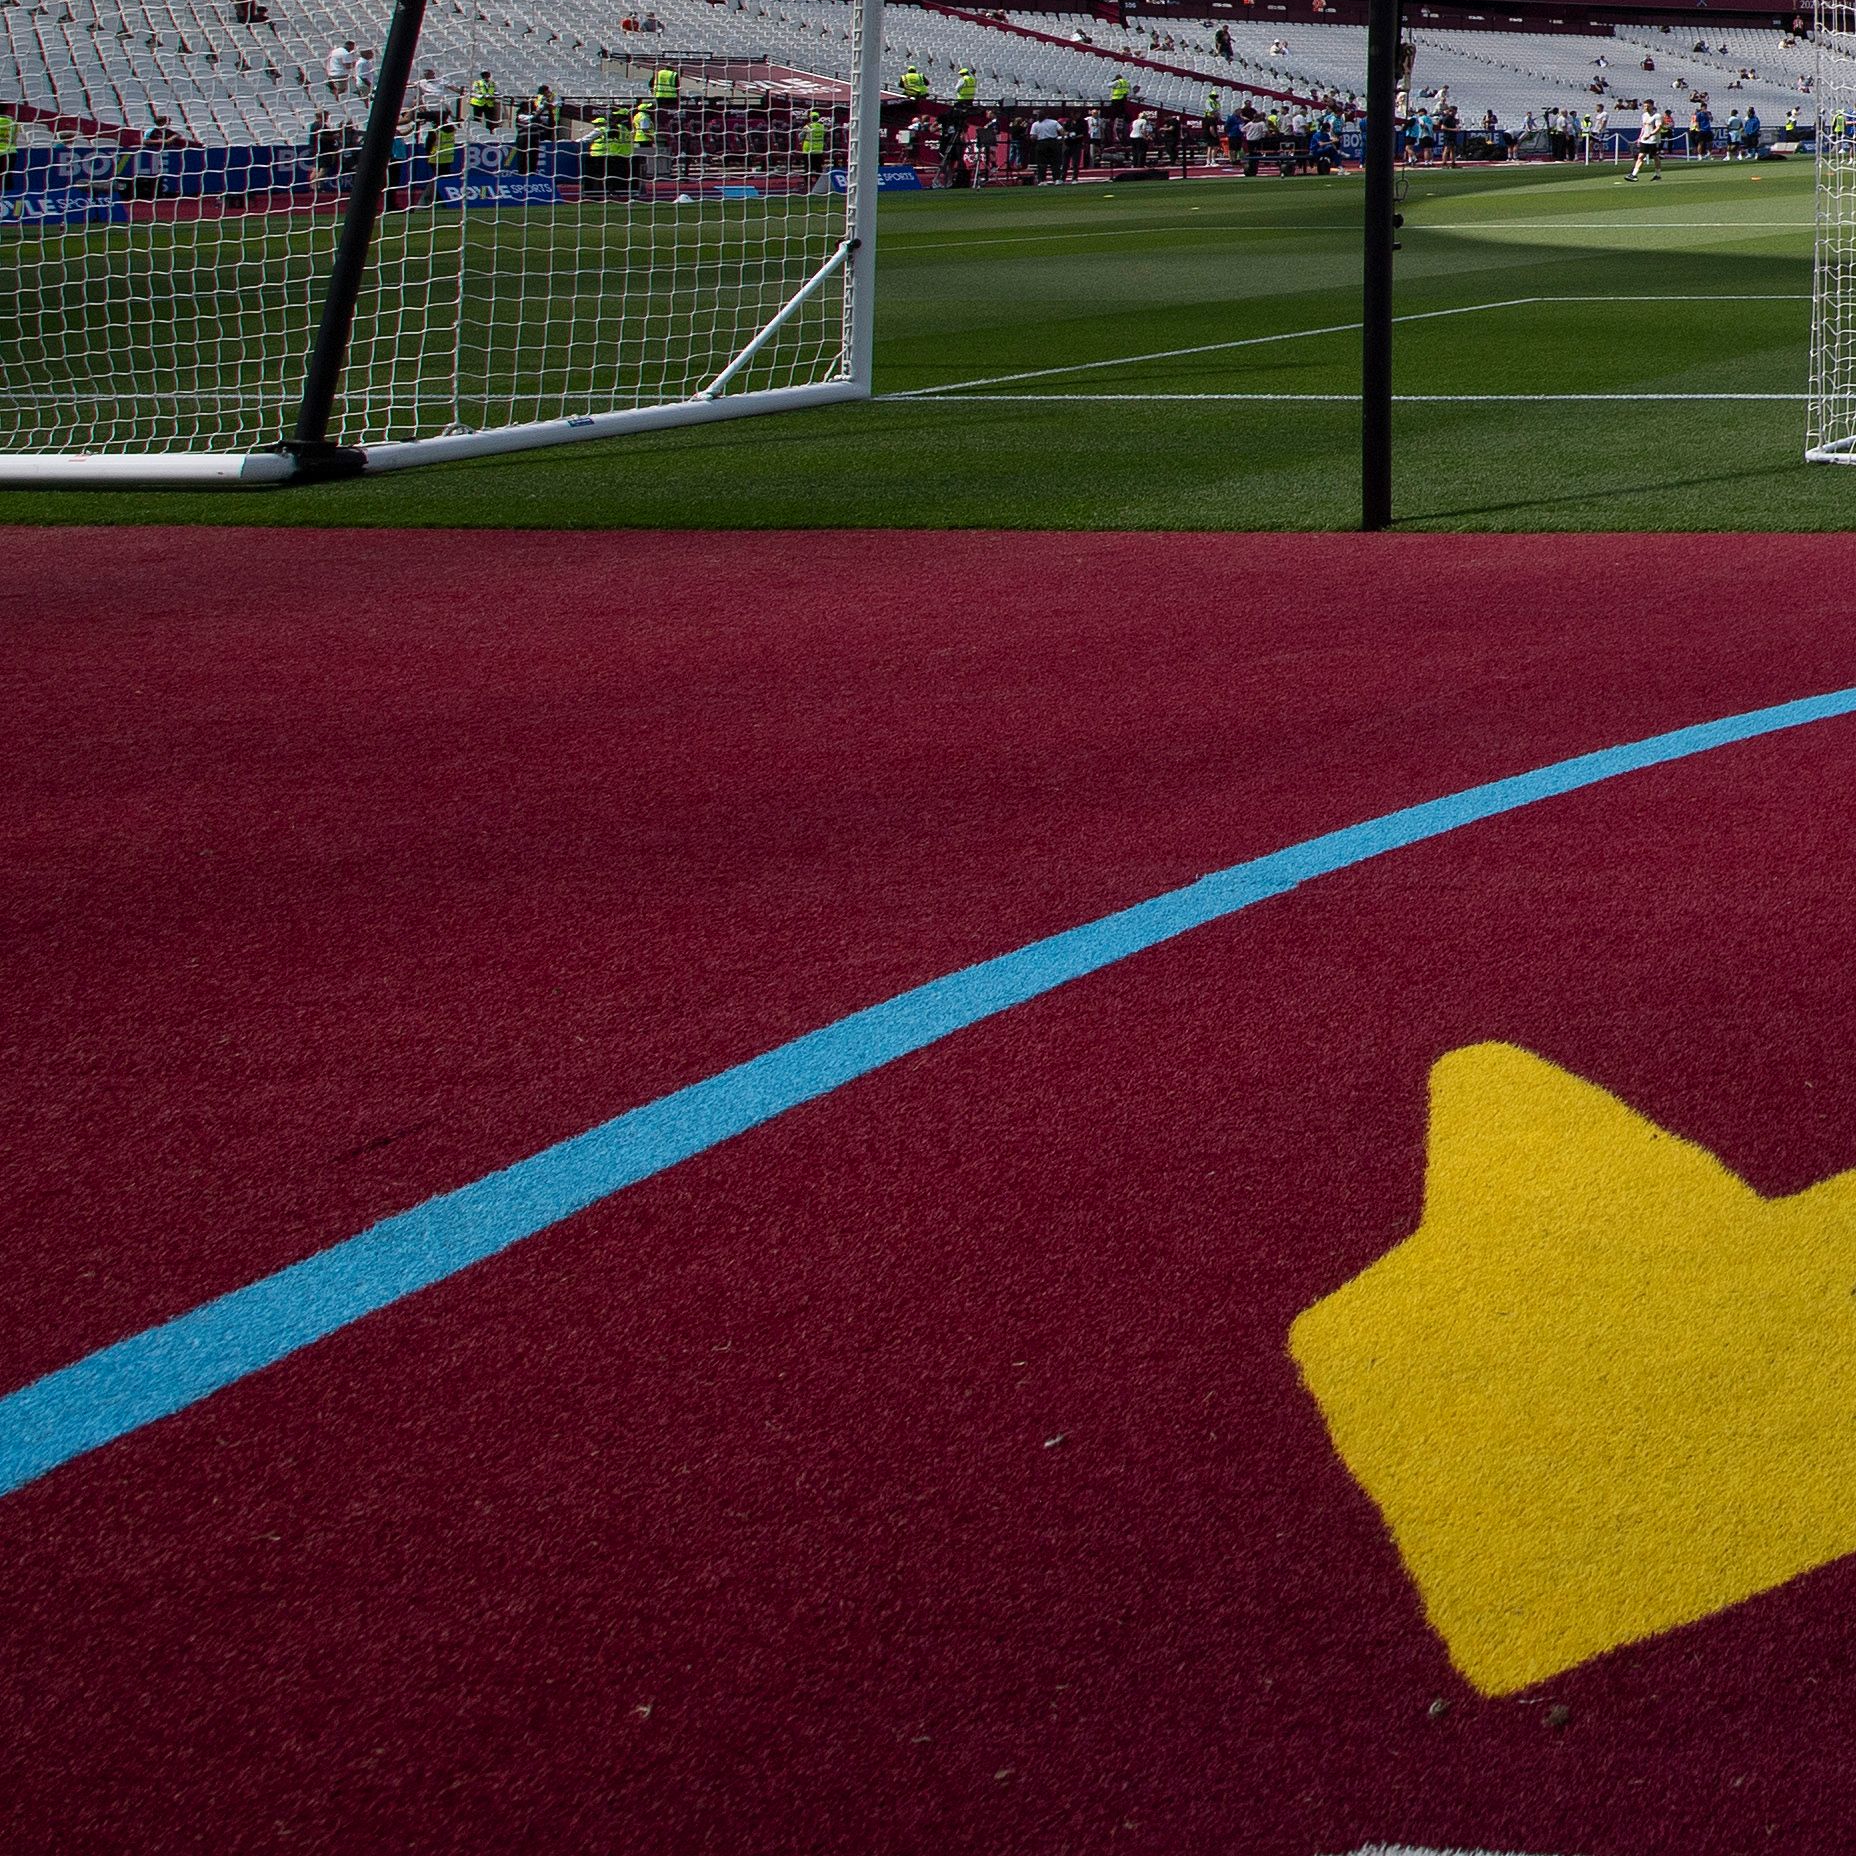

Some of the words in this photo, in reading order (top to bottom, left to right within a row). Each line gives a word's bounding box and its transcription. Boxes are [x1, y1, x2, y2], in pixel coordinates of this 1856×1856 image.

[58, 151, 170, 177] BOYLE
[883, 171, 915, 182] SPORTS
[445, 185, 513, 201] BOYLE
[510, 183, 553, 194] SPORTS
